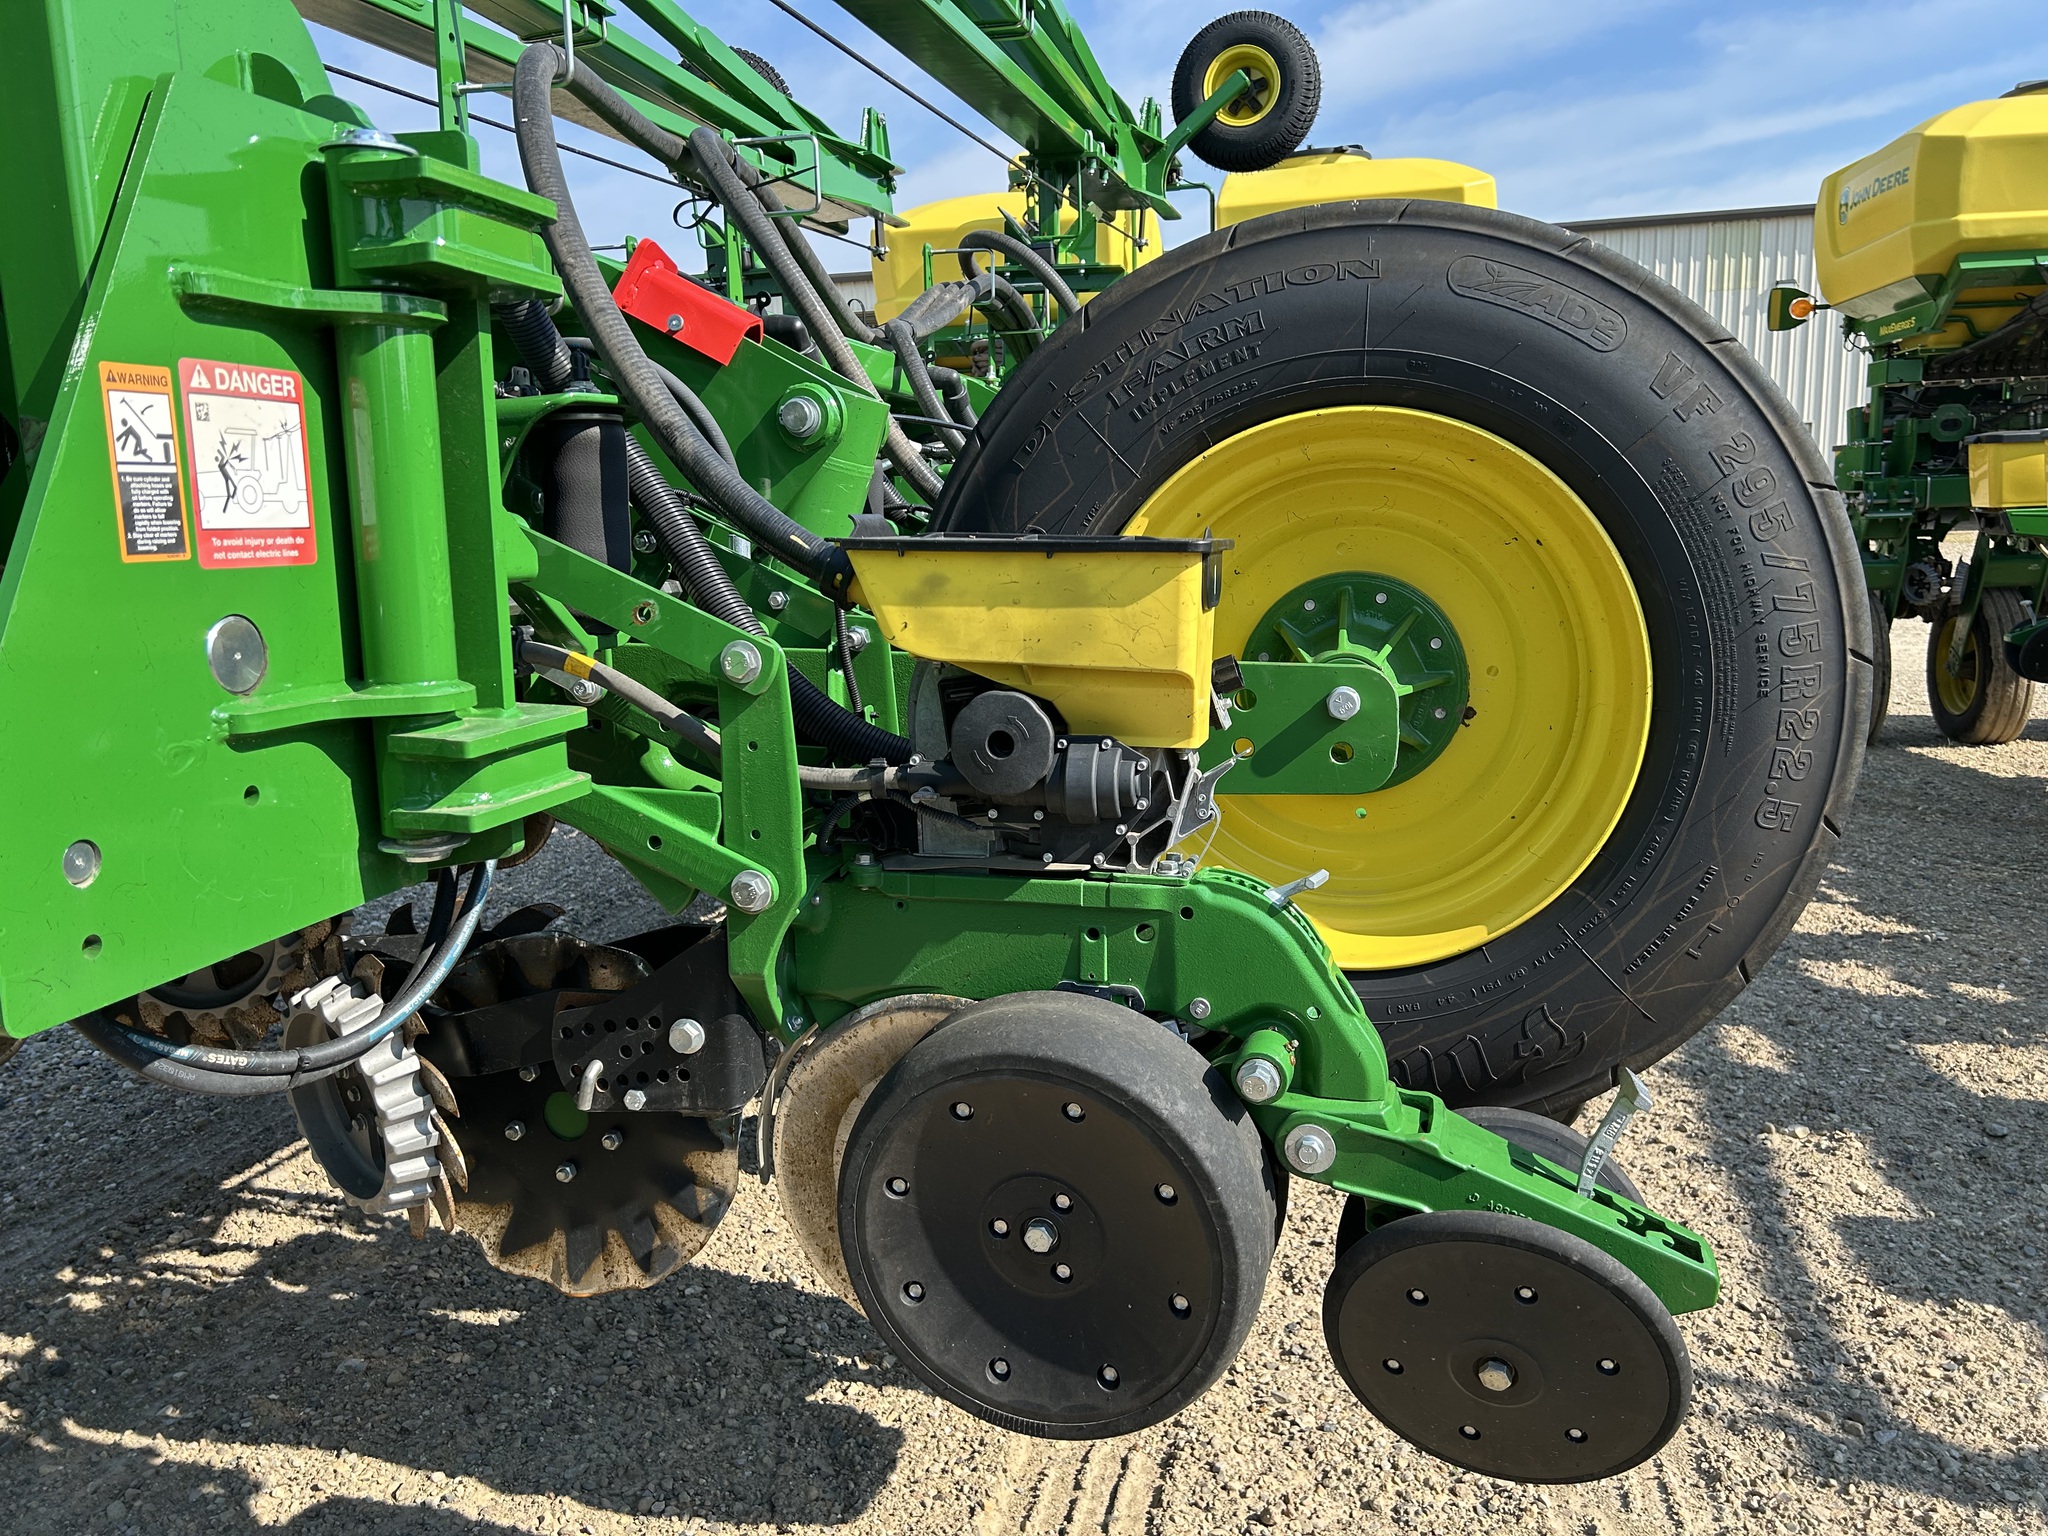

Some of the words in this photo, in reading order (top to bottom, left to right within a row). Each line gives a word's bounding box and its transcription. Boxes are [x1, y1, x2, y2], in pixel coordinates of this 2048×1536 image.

[1850, 184, 1872, 211] JOHN
[1872, 166, 1910, 198] DEERE
[117, 371, 168, 387] WARNING
[214, 367, 296, 397] DANGER
[1012, 259, 1382, 471] DESTINATION
[1106, 309, 1266, 410] FARM
[1129, 341, 1262, 423] IMPLEMENT
[211, 537, 221, 546] To
[222, 536, 243, 546] avoid
[244, 536, 265, 547] injury
[266, 537, 274, 545] or
[275, 536, 294, 545] death
[295, 536, 305, 544] do
[213, 551, 226, 560] not
[226, 550, 254, 559] contact
[255, 549, 281, 558] electric
[282, 548, 299, 557] lines
[1649, 350, 1725, 422] VF
[1709, 431, 1823, 832] 295/75R22.5
[1708, 492, 1734, 522] NOT
[1725, 526, 1747, 557] FOR
[1739, 562, 1766, 626] HIGHWAY
[1756, 632, 1770, 699] SERVICE
[1693, 864, 1719, 896] NOT
[1675, 894, 1700, 922] FOR
[1622, 923, 1677, 976] RETREAD
